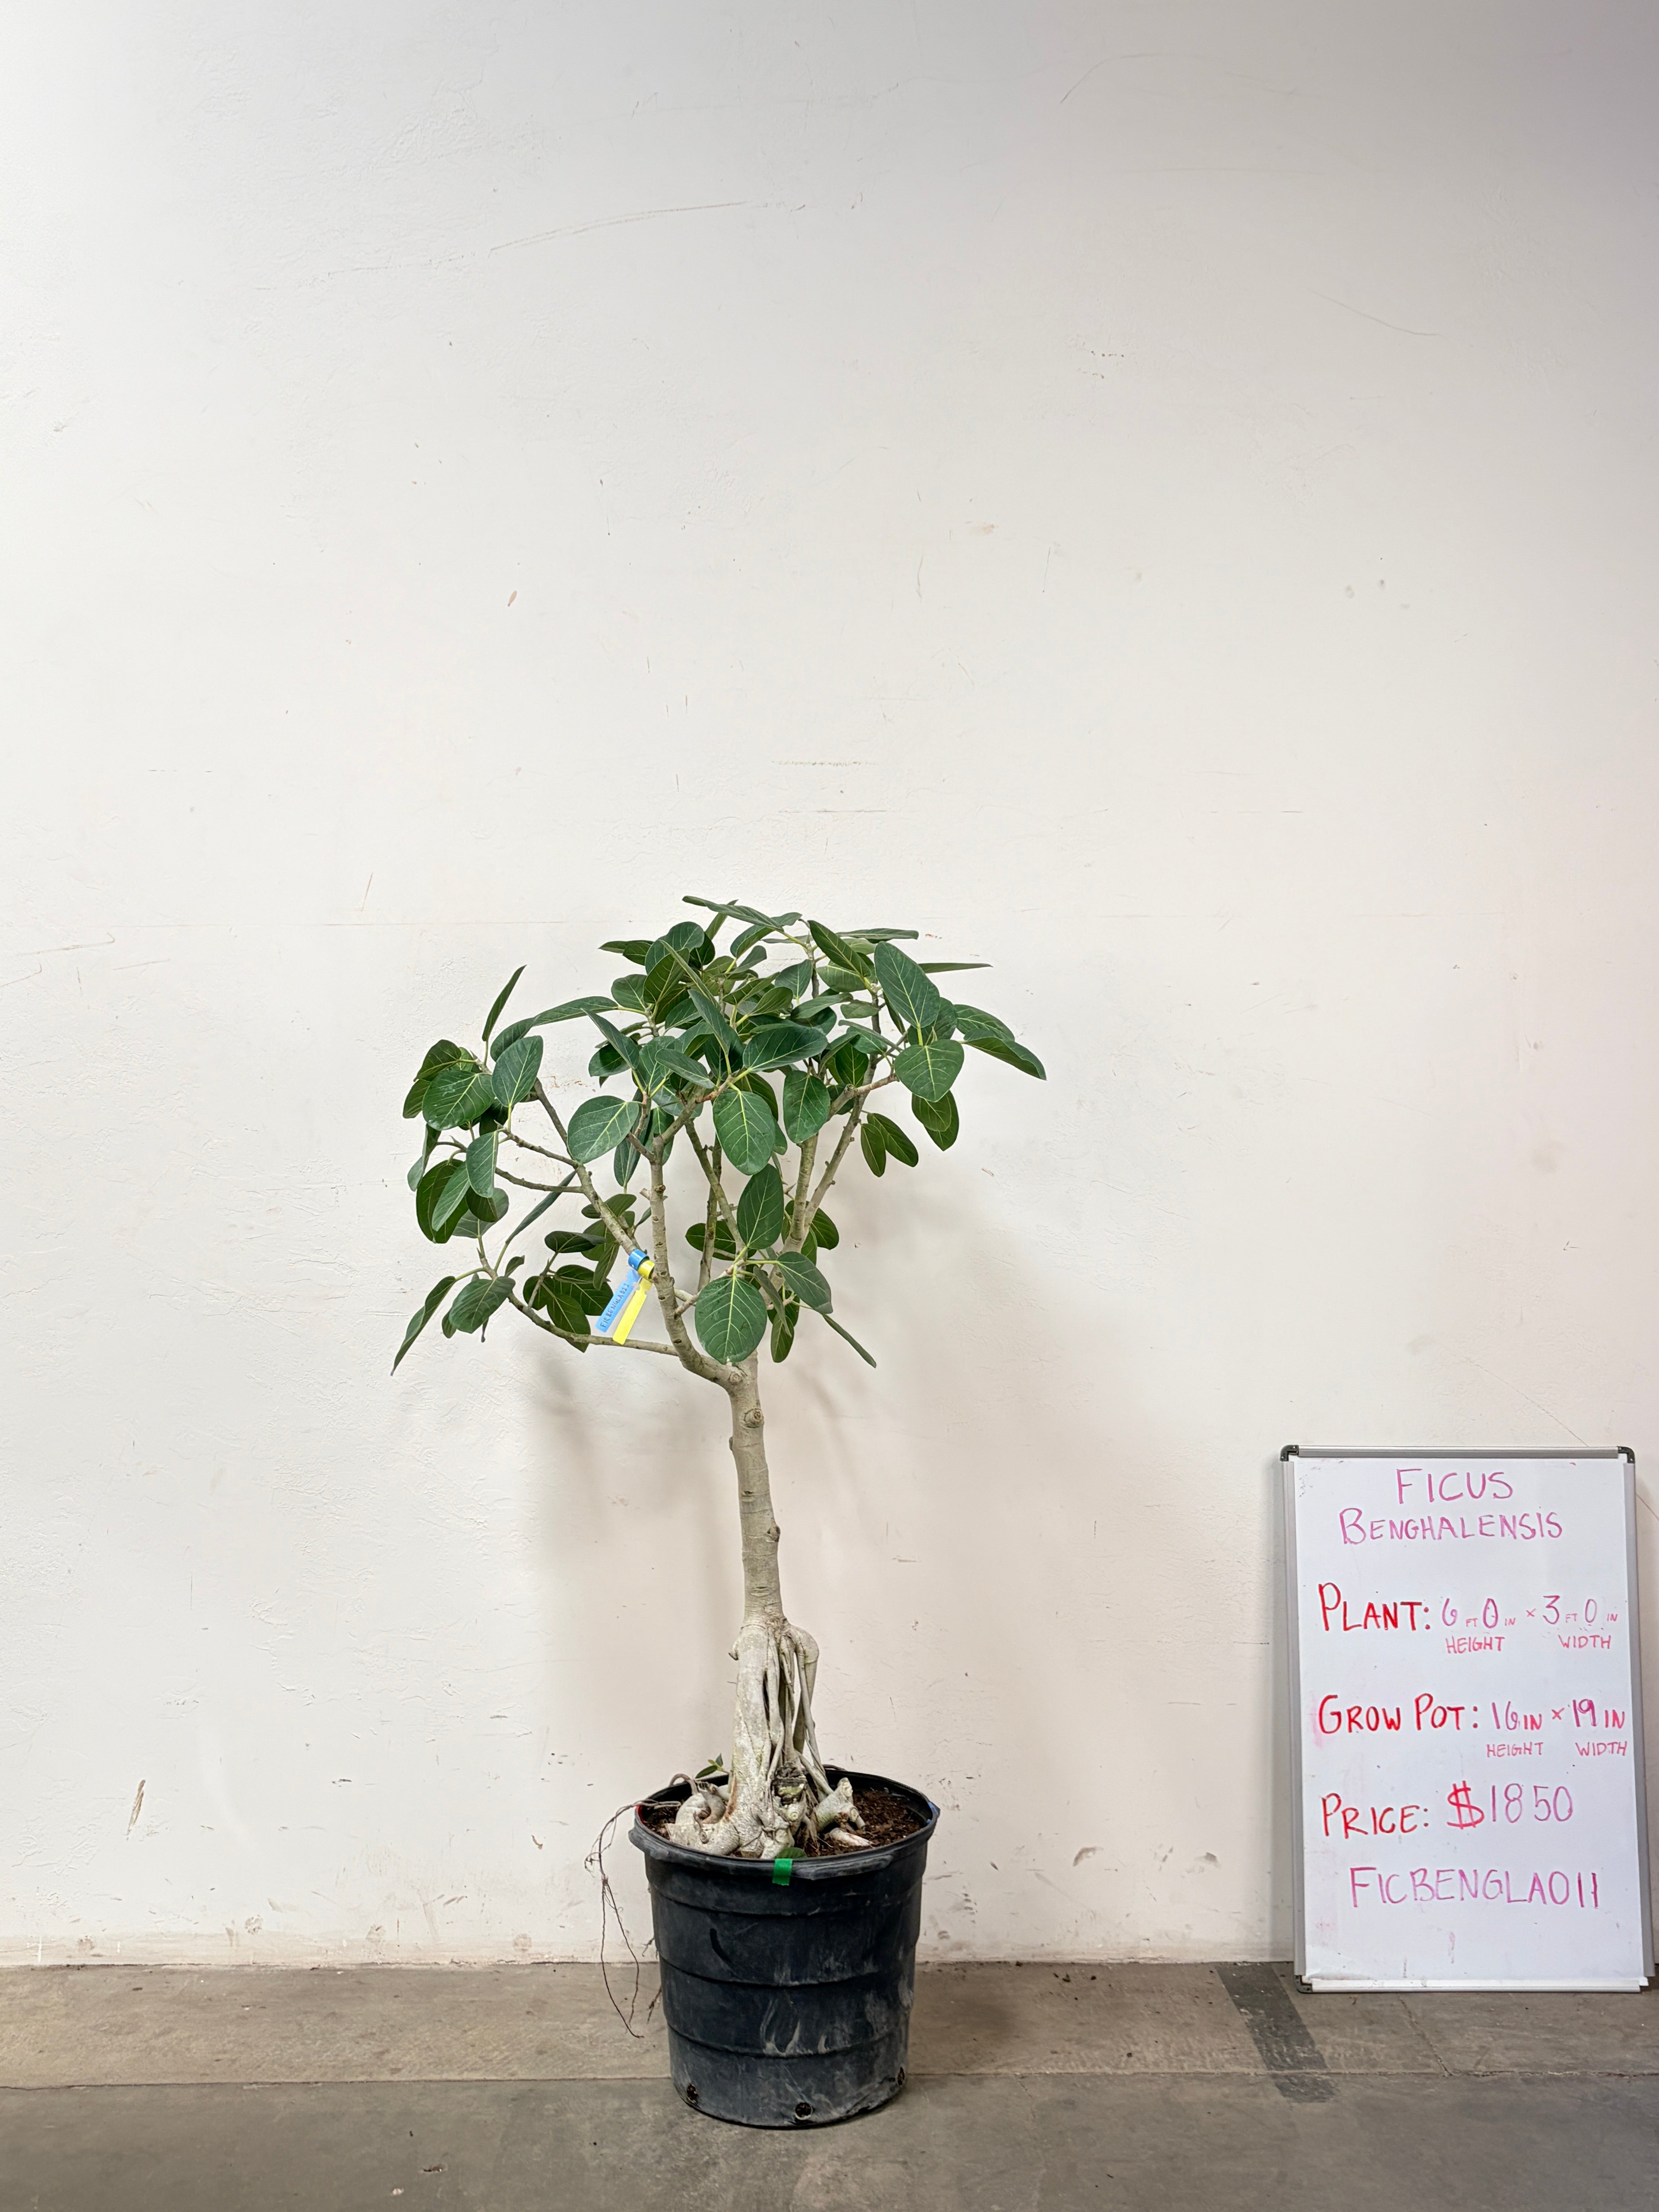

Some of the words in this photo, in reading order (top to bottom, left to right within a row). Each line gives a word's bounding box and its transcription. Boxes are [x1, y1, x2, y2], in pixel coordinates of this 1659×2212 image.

[1396, 1468, 1513, 1504] FICUS
[1339, 1508, 1563, 1544] BENGHALENSIS
[1318, 1582, 1431, 1632] PLANT:
[1442, 1598, 1457, 1626] 6
[1543, 1595, 1560, 1625] 3
[1446, 1637, 1505, 1654] HEIGHT
[1558, 1635, 1611, 1649] WIDTH
[1319, 1694, 1401, 1734] GROW
[1414, 1693, 1479, 1731] POT:
[1486, 1741, 1544, 1757] HEIGHT
[1575, 1741, 1627, 1757] WIDTH
[1321, 1793, 1428, 1839] PRICE:
[1446, 1780, 1573, 1830] $1850
